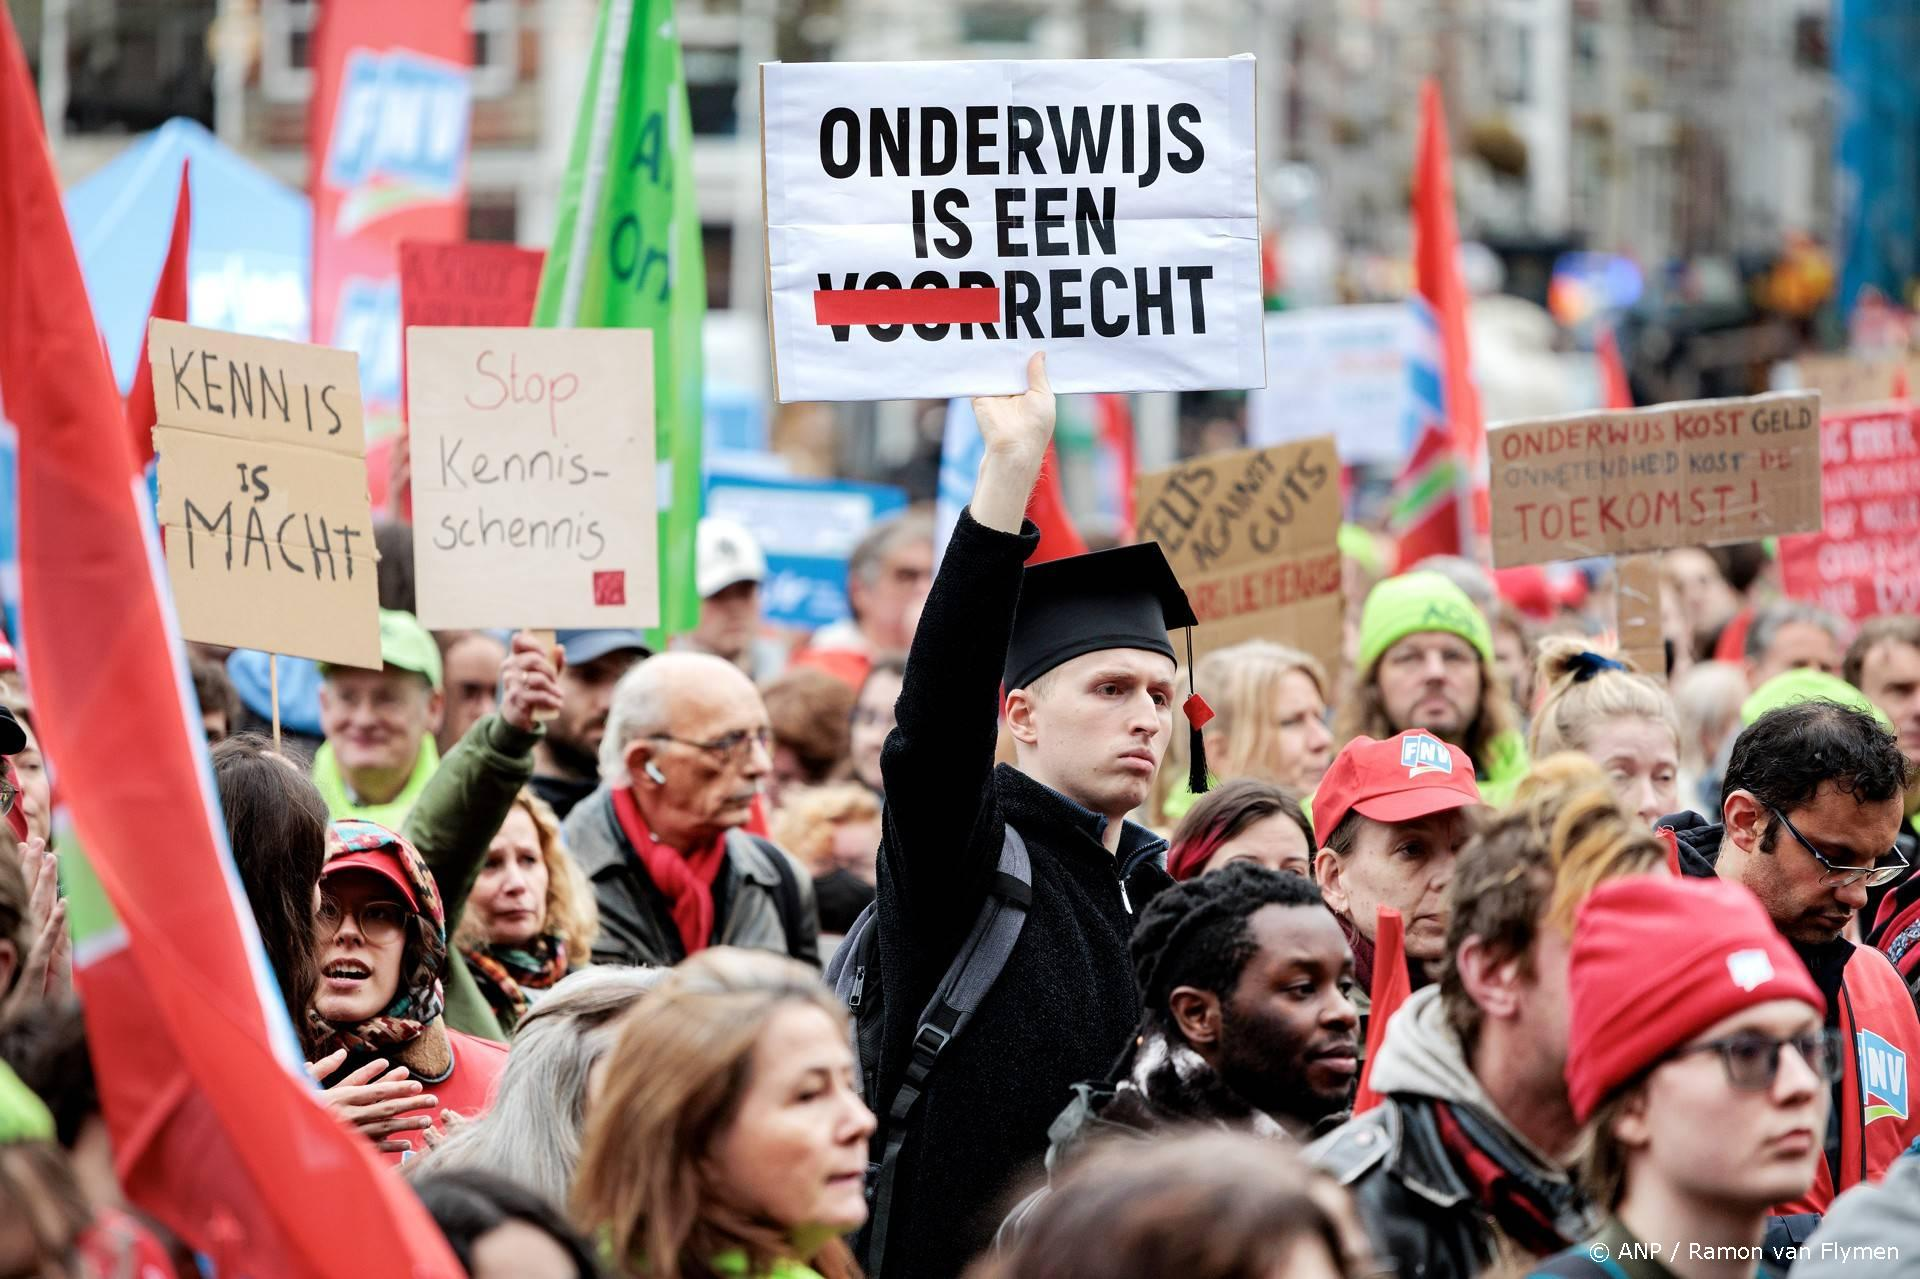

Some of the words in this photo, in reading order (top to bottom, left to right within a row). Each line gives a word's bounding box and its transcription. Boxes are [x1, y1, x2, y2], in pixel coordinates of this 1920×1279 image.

[819, 102, 1206, 189] ONDERWIJS
[911, 188, 973, 260] IS
[995, 186, 1117, 258] EEN
[170, 345, 343, 436] KENNIS
[464, 349, 580, 438] Stop
[439, 434, 610, 489] Kennis-
[1501, 419, 1666, 461] ONDERWIJS
[1674, 409, 1746, 443] KOST
[1752, 408, 1812, 434] GELD
[1688, 452, 1745, 475] KOST
[236, 462, 271, 503] IS
[1249, 448, 1329, 554] CUTS
[184, 497, 362, 582] MACHT
[1403, 741, 1450, 764] FNV
[1858, 1046, 1904, 1097] NV
